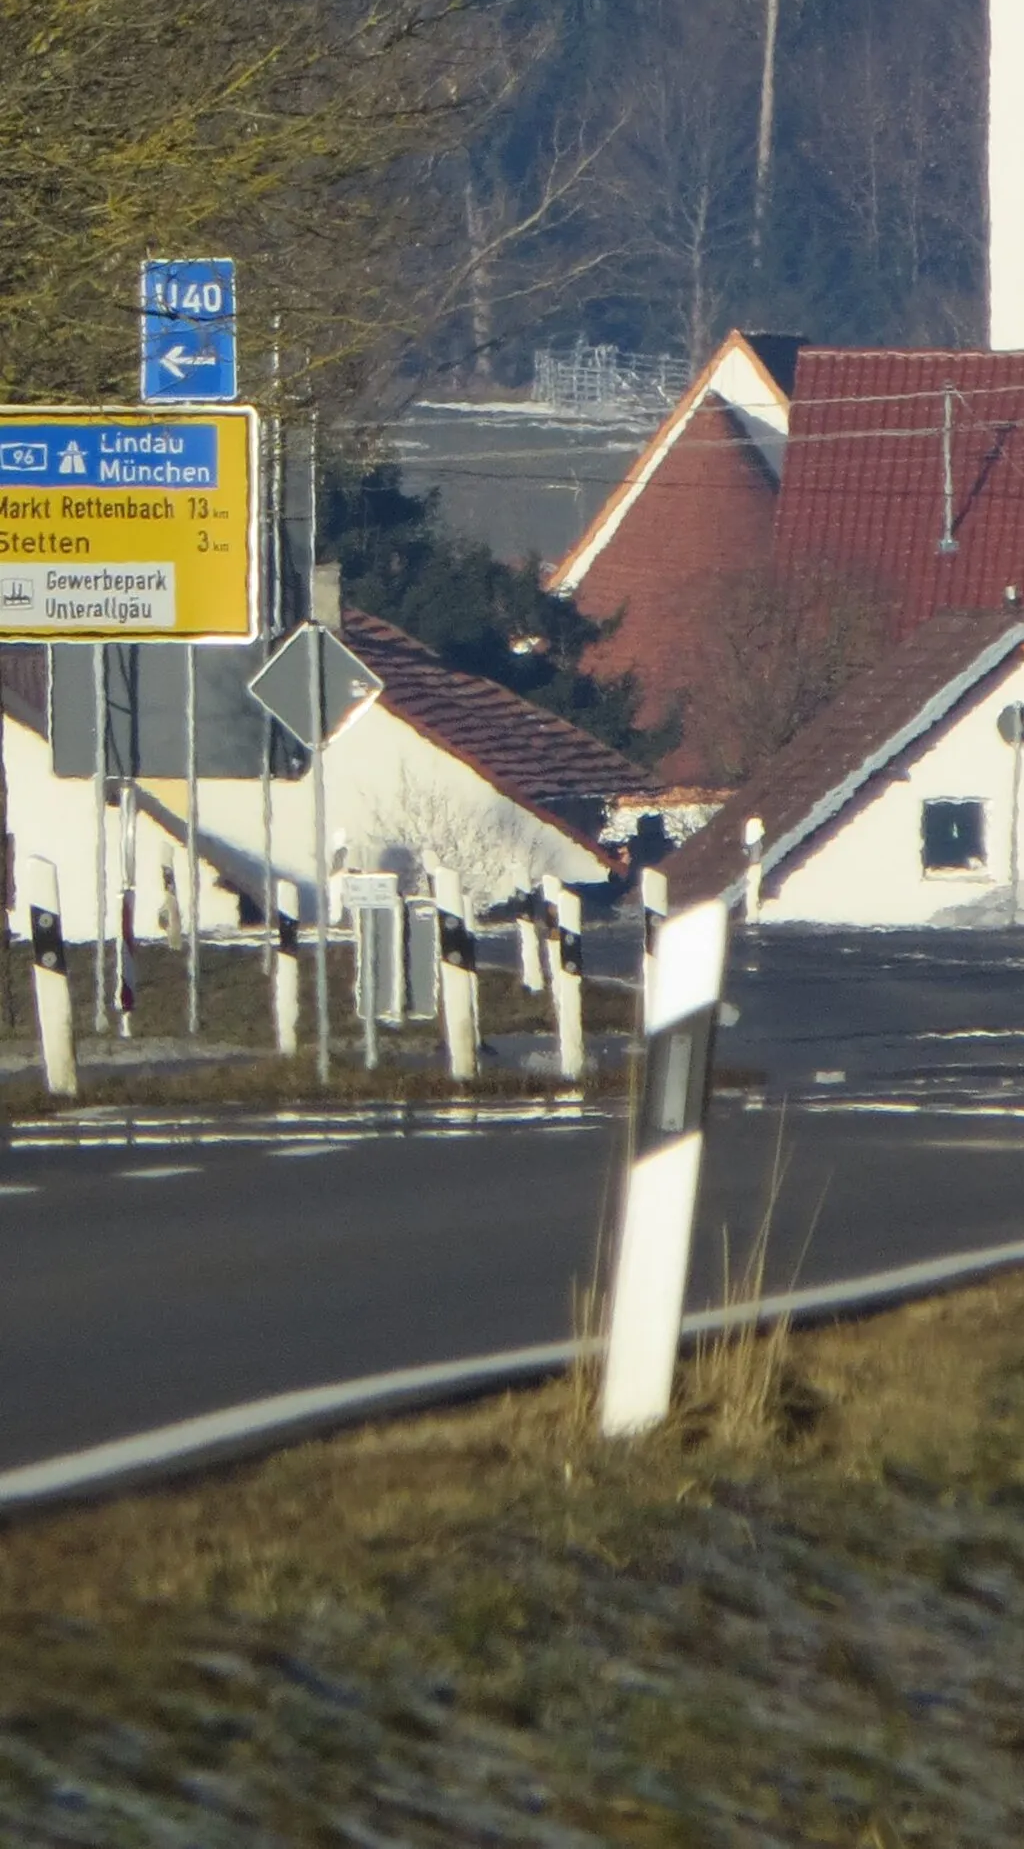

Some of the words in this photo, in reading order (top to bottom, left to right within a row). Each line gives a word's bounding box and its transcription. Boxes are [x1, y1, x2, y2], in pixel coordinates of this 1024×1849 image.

[155, 282, 222, 313] U40
[99, 431, 184, 454] Lindau
[12, 449, 35, 466] 96
[100, 459, 211, 483] München
[61, 496, 175, 520] Rettenbach
[188, 497, 209, 519] 13
[212, 508, 229, 520] km
[0, 531, 90, 554] Stetten
[197, 530, 209, 553] 3
[212, 540, 229, 552] km
[46, 568, 167, 594] Gewerbepark
[45, 597, 153, 624] Unterallgäu
